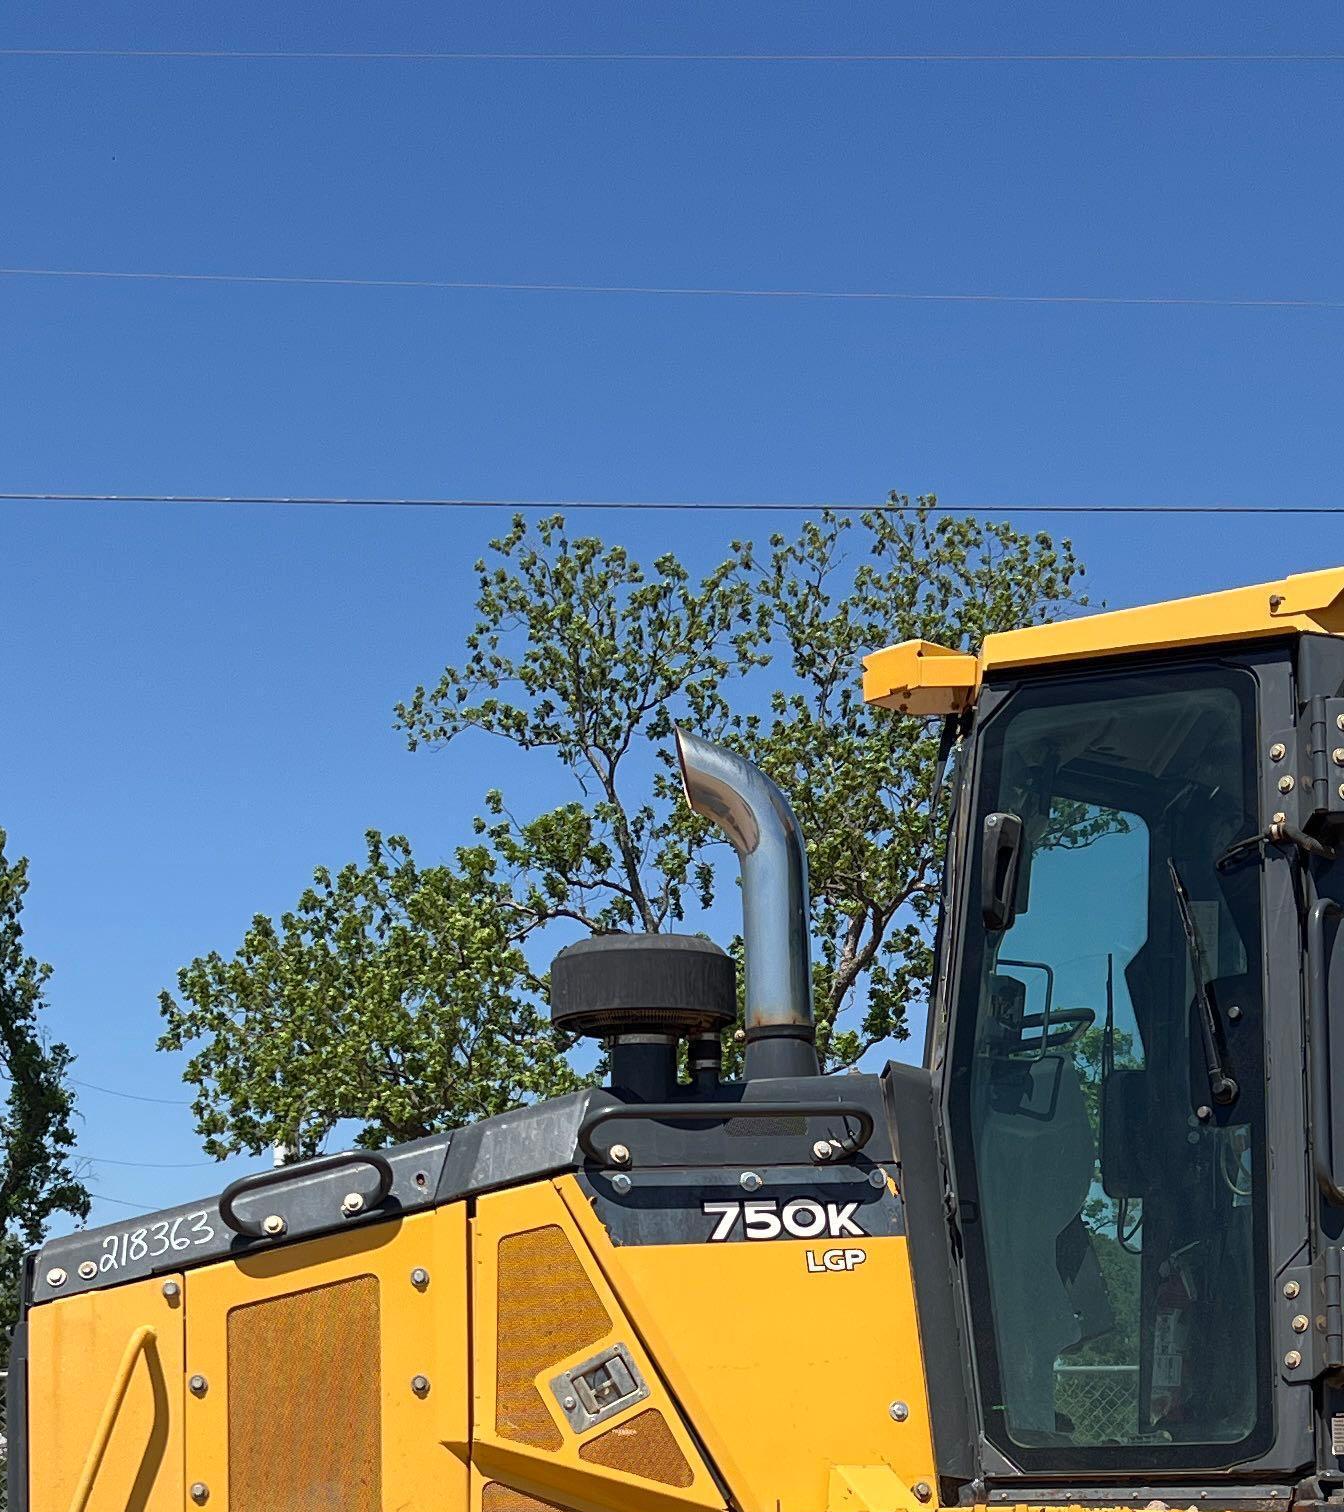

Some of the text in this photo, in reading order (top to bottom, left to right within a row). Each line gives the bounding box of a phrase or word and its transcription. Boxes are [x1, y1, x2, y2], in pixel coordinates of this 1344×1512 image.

[703, 1197, 868, 1241] 750K
[99, 1210, 215, 1273] 218363
[806, 1248, 866, 1273] LGP
